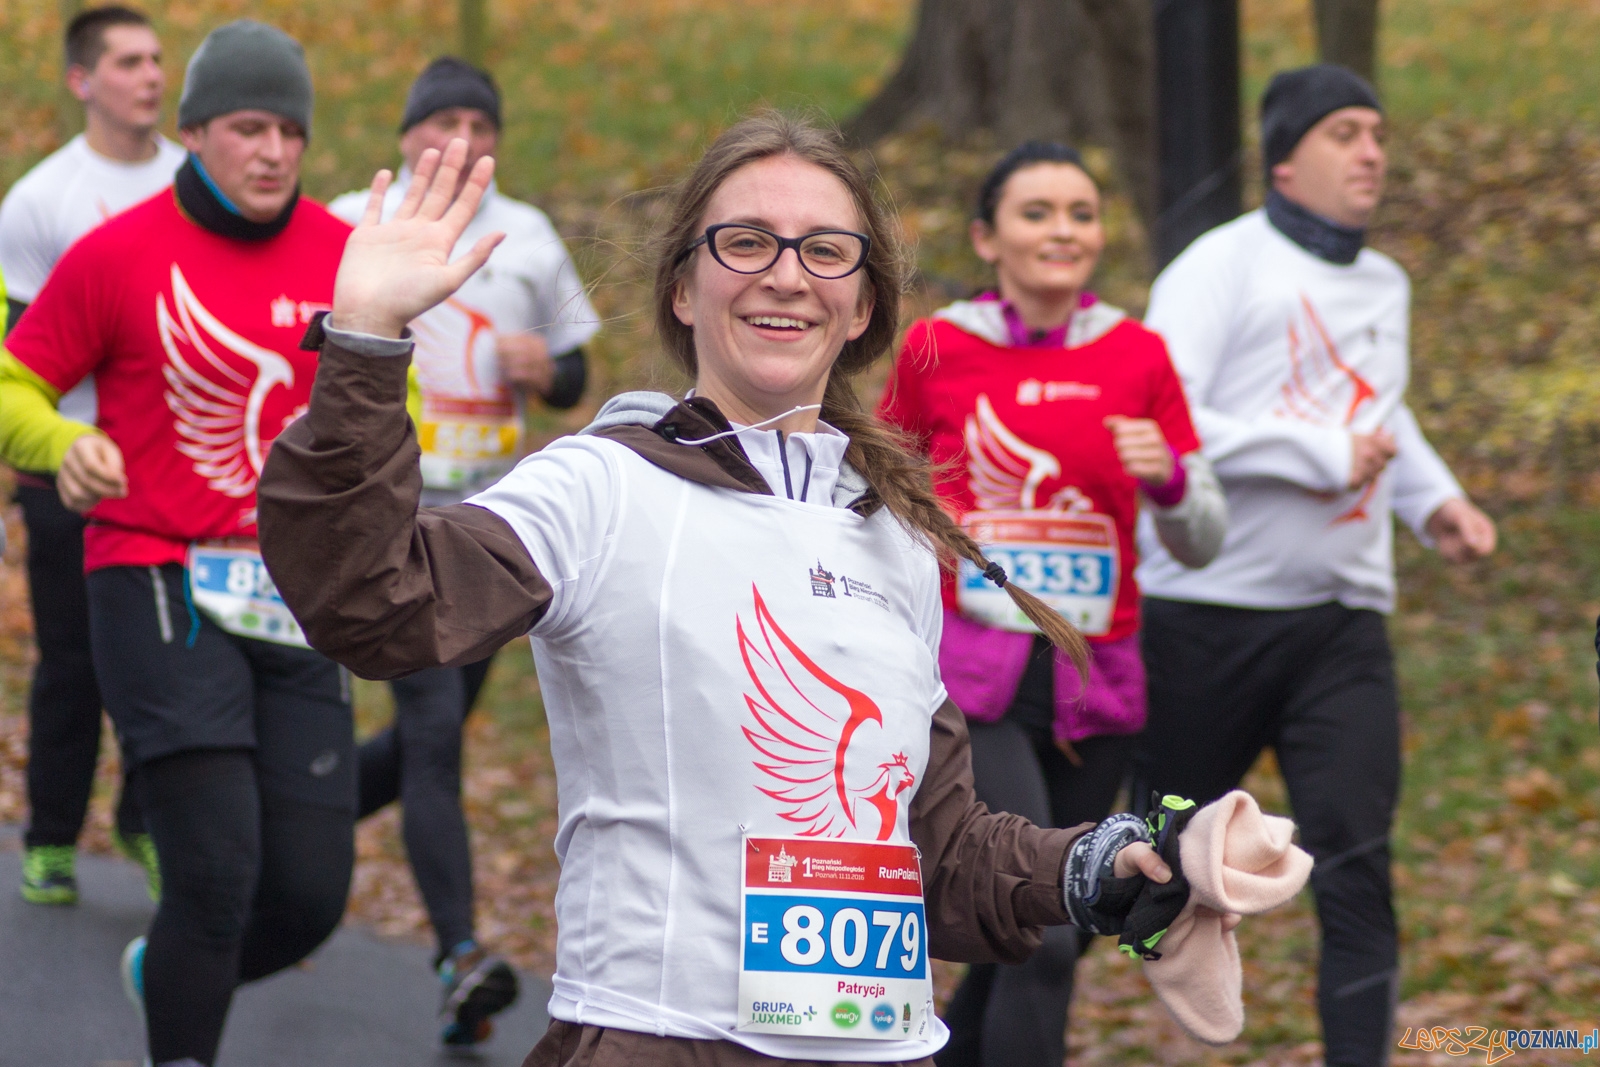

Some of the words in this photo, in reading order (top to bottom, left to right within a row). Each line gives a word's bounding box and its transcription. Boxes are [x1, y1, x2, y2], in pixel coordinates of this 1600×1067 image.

[802, 857, 813, 877] 1
[751, 922, 769, 944] E
[780, 904, 920, 972] 8079
[837, 980, 885, 998] Patrycja
[752, 1001, 795, 1014] GRUPA
[752, 1013, 802, 1026] LUXMED
[835, 1011, 859, 1024] energy
